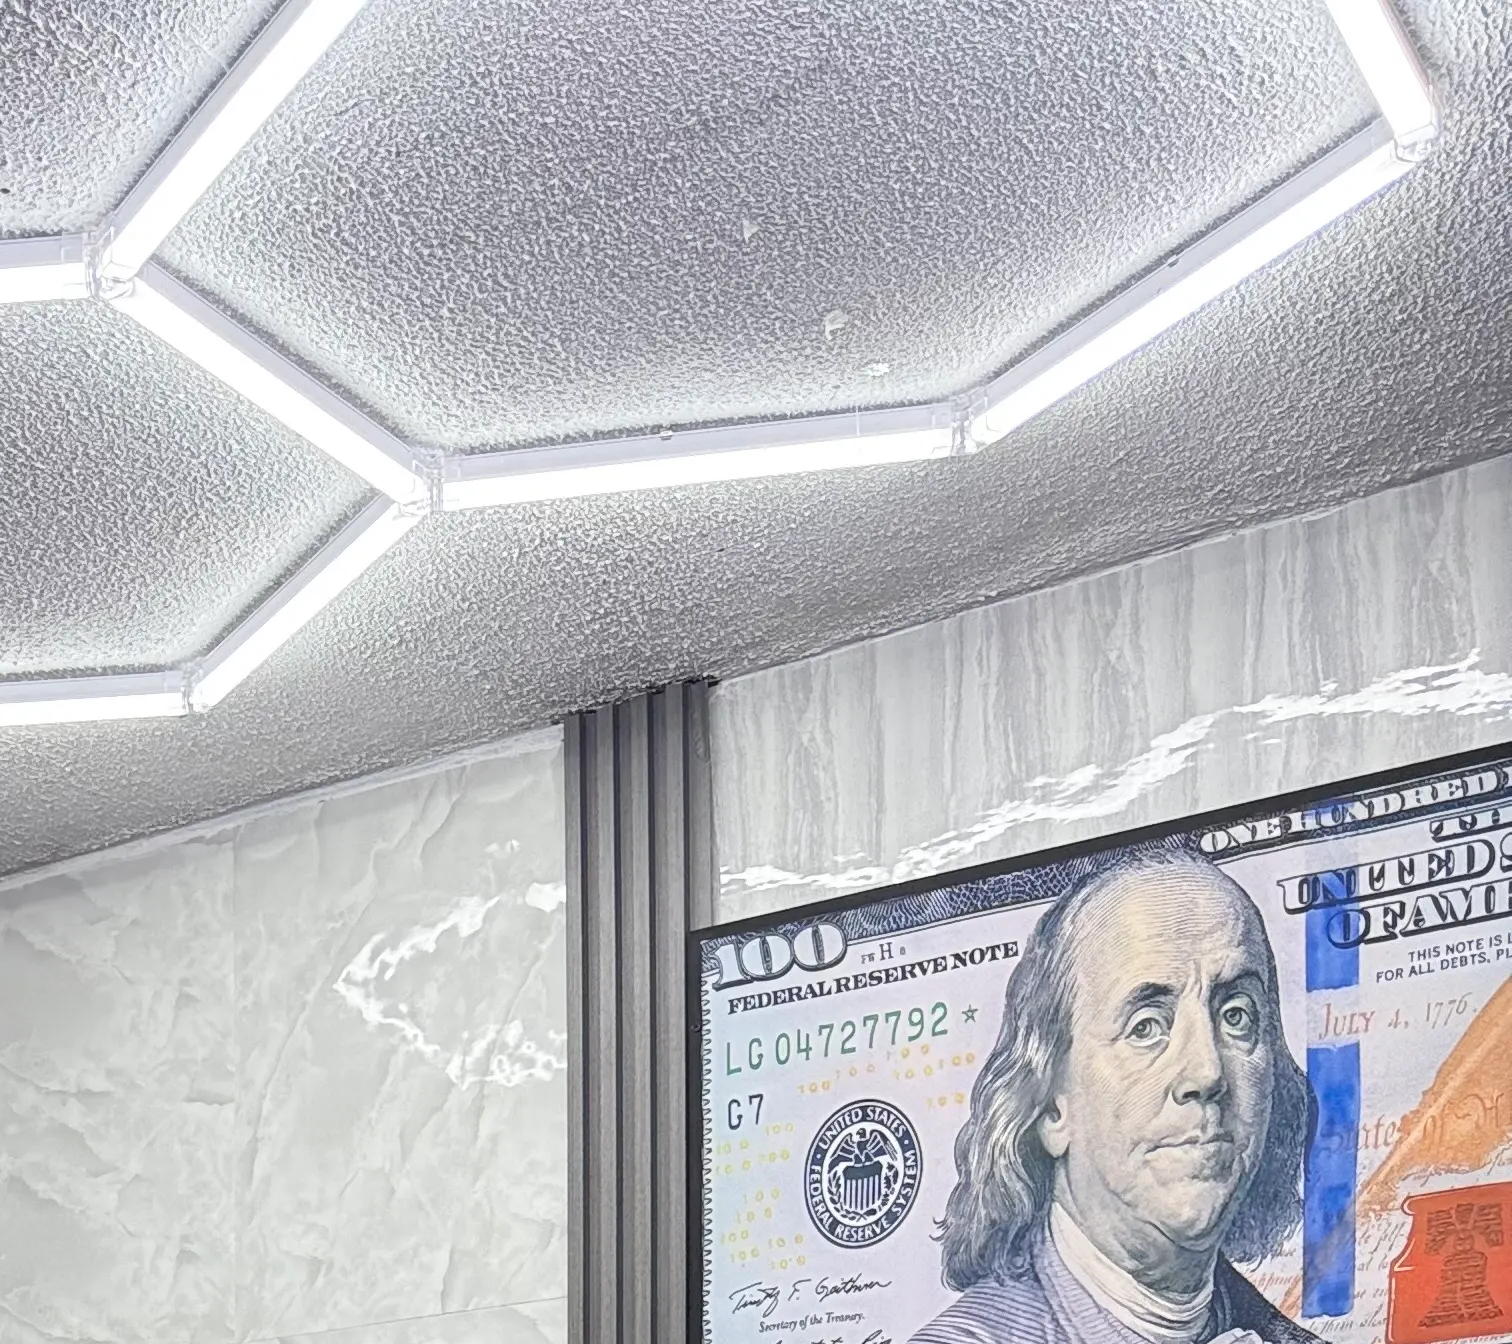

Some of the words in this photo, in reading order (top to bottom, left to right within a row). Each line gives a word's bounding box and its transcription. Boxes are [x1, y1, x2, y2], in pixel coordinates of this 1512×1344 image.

[1200, 815, 1289, 853] ONE
[1288, 767, 1508, 831] HUNDRED
[1277, 839, 1496, 916] UNITED
[712, 922, 848, 991] 100
[879, 941, 895, 961] H
[1408, 946, 1441, 963] THIS
[1445, 937, 1484, 956] NOTE
[1488, 935, 1503, 949] IS
[728, 981, 833, 1015] FEDERAL
[834, 956, 948, 994] RESERVE
[950, 941, 1020, 969] NOTE
[1376, 967, 1405, 984] FOR
[1408, 962, 1436, 979] ALL
[727, 1093, 765, 1131] G7
[819, 1107, 863, 1150] UNITED
[865, 1105, 908, 1138] STATES
[809, 1164, 833, 1231] FEDERAL
[834, 1217, 891, 1243] RESERVE
[891, 1149, 918, 1217] SYSTEM
[798, 1314, 810, 1329] of
[809, 1313, 823, 1326] the
